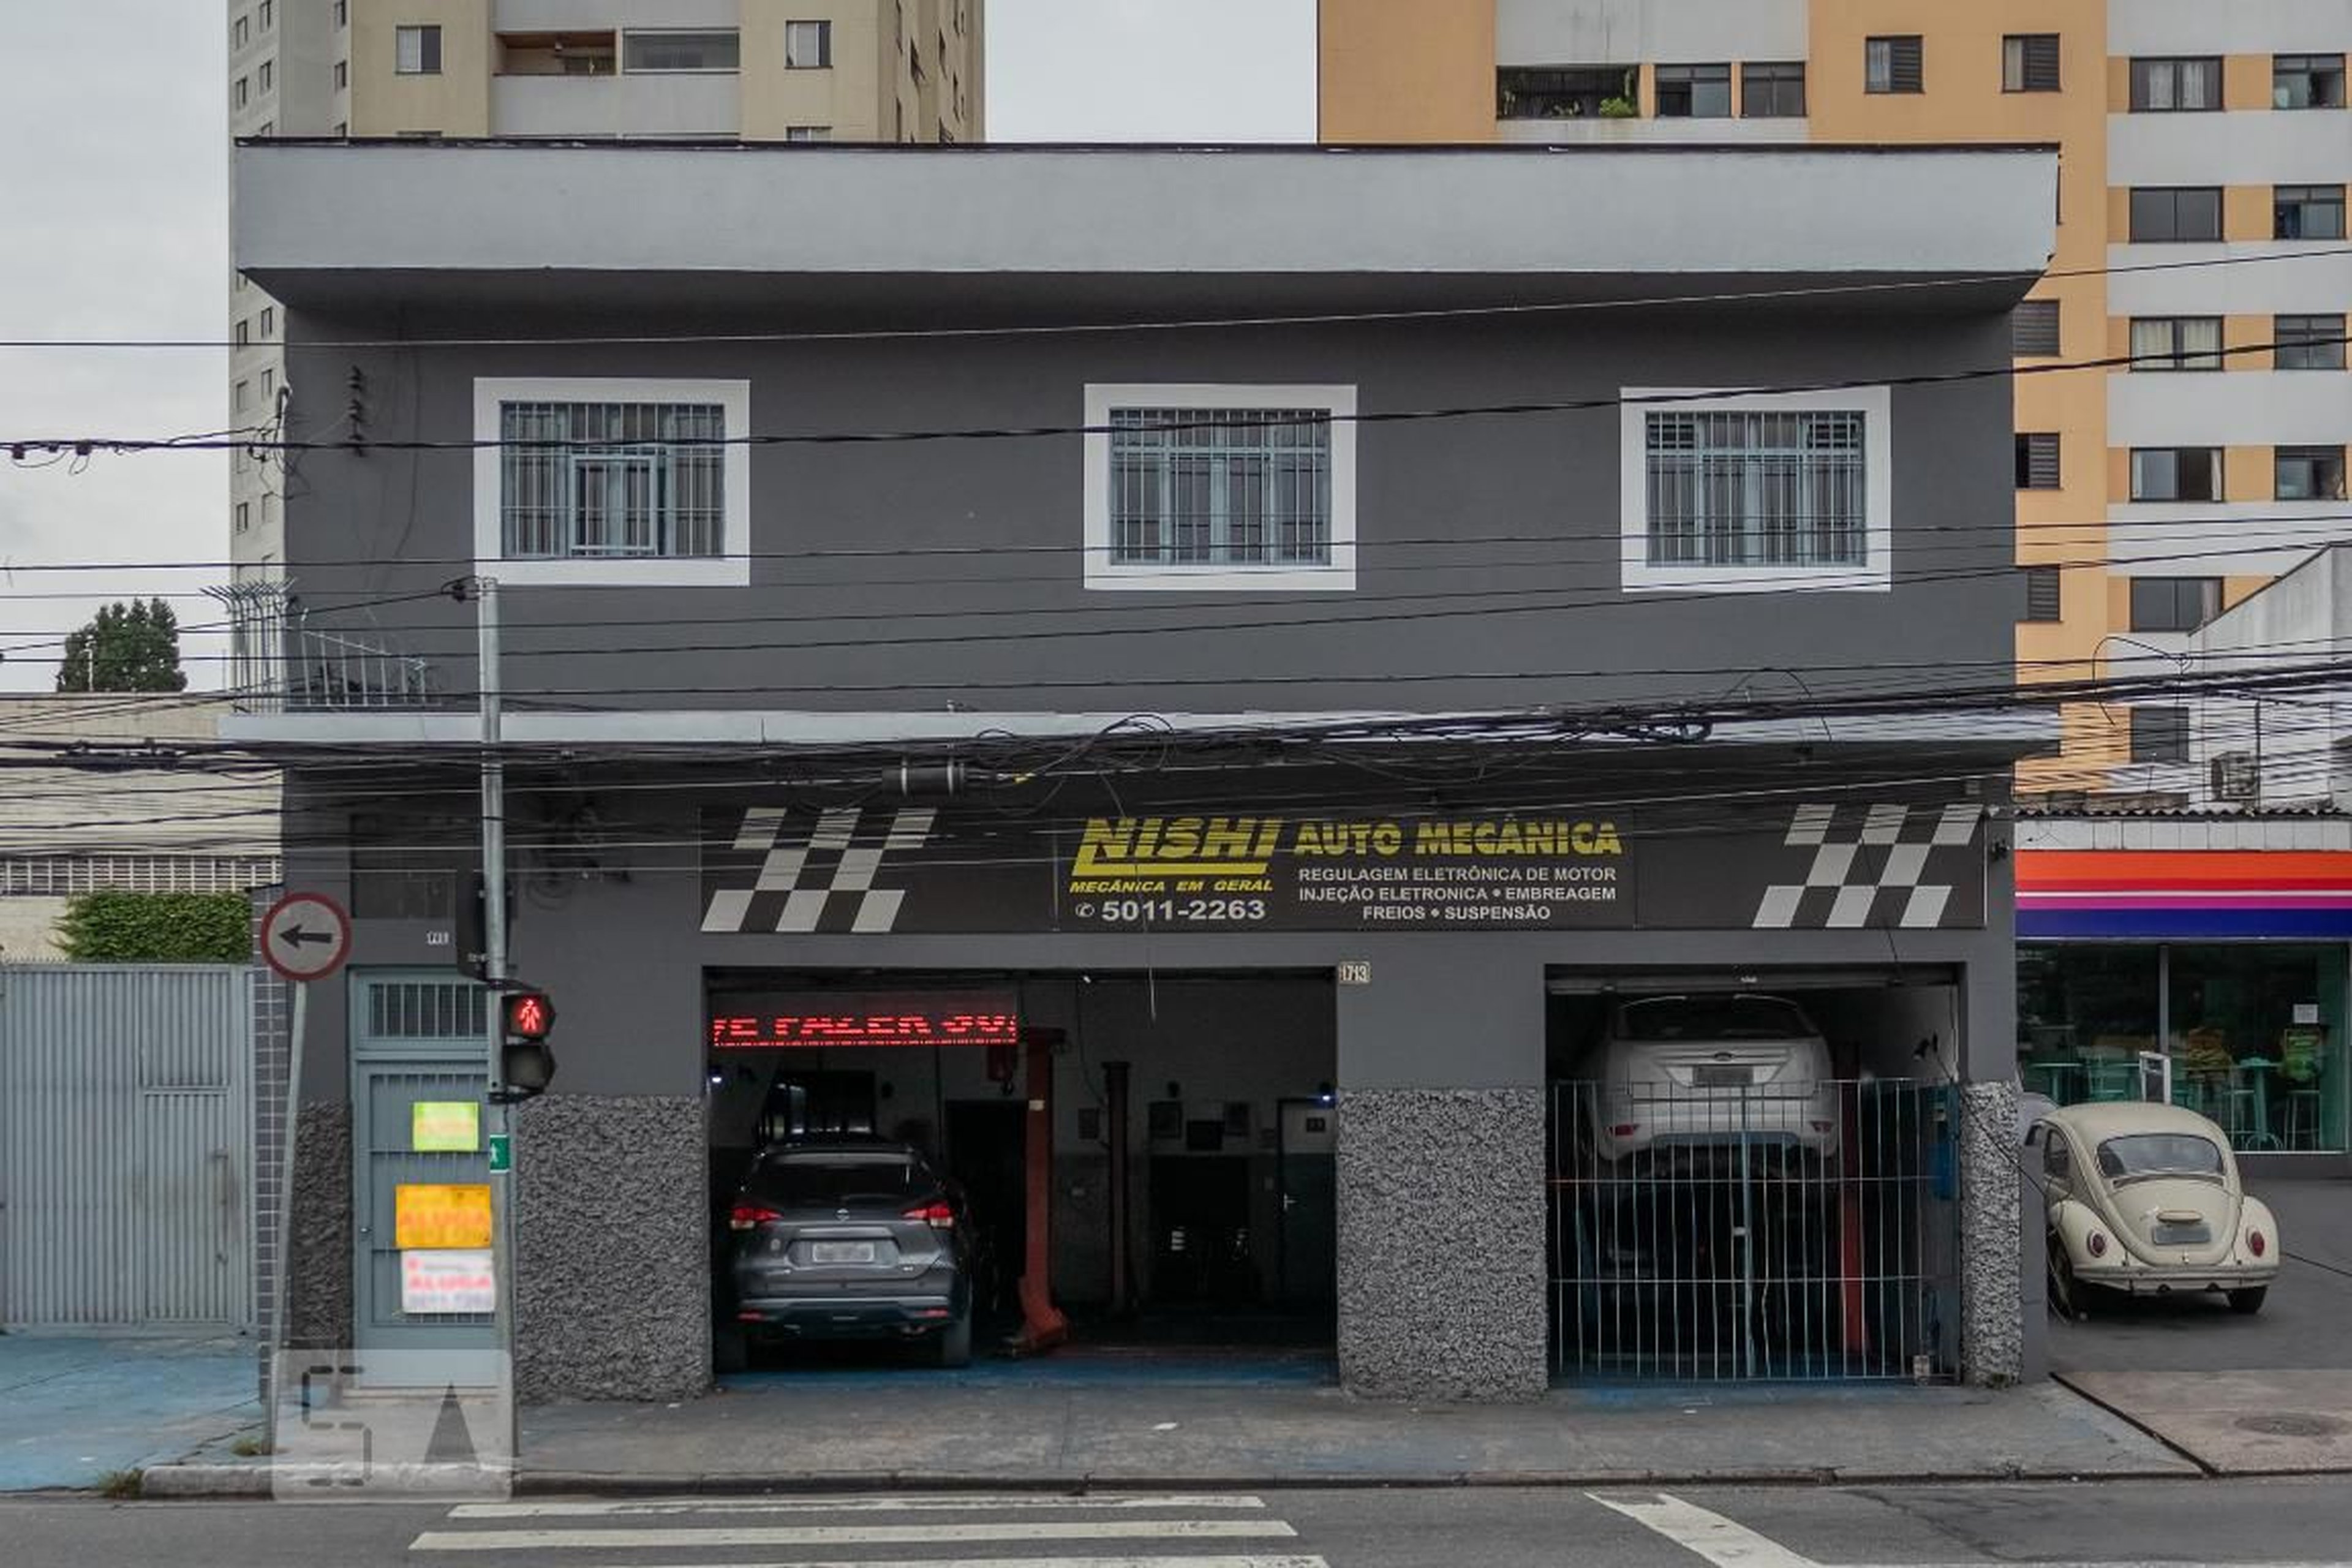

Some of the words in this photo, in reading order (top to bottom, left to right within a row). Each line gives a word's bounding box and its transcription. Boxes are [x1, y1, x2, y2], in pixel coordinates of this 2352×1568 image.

[1294, 823, 1402, 855] AUTO
[1415, 813, 1622, 854] MECÂNICA
[1072, 818, 1283, 875] NISHI
[1298, 867, 1408, 881] REGULAGEM
[1412, 865, 1522, 881] ELETRÔNICA
[1526, 867, 1548, 881] DE
[1555, 867, 1616, 881] MOTOR
[1175, 880, 1204, 892] EM
[1213, 880, 1273, 892] GERAL
[1299, 885, 1374, 903] INJEÇÃO
[1379, 888, 1488, 901] ELETRONICA
[1506, 888, 1616, 900] EMBREAGEM
[1102, 900, 1266, 921] 5011-2263
[1363, 906, 1425, 919] FREIOS
[1444, 903, 1551, 919] SUSPENSÃO
[1343, 965, 1366, 982] 1713
